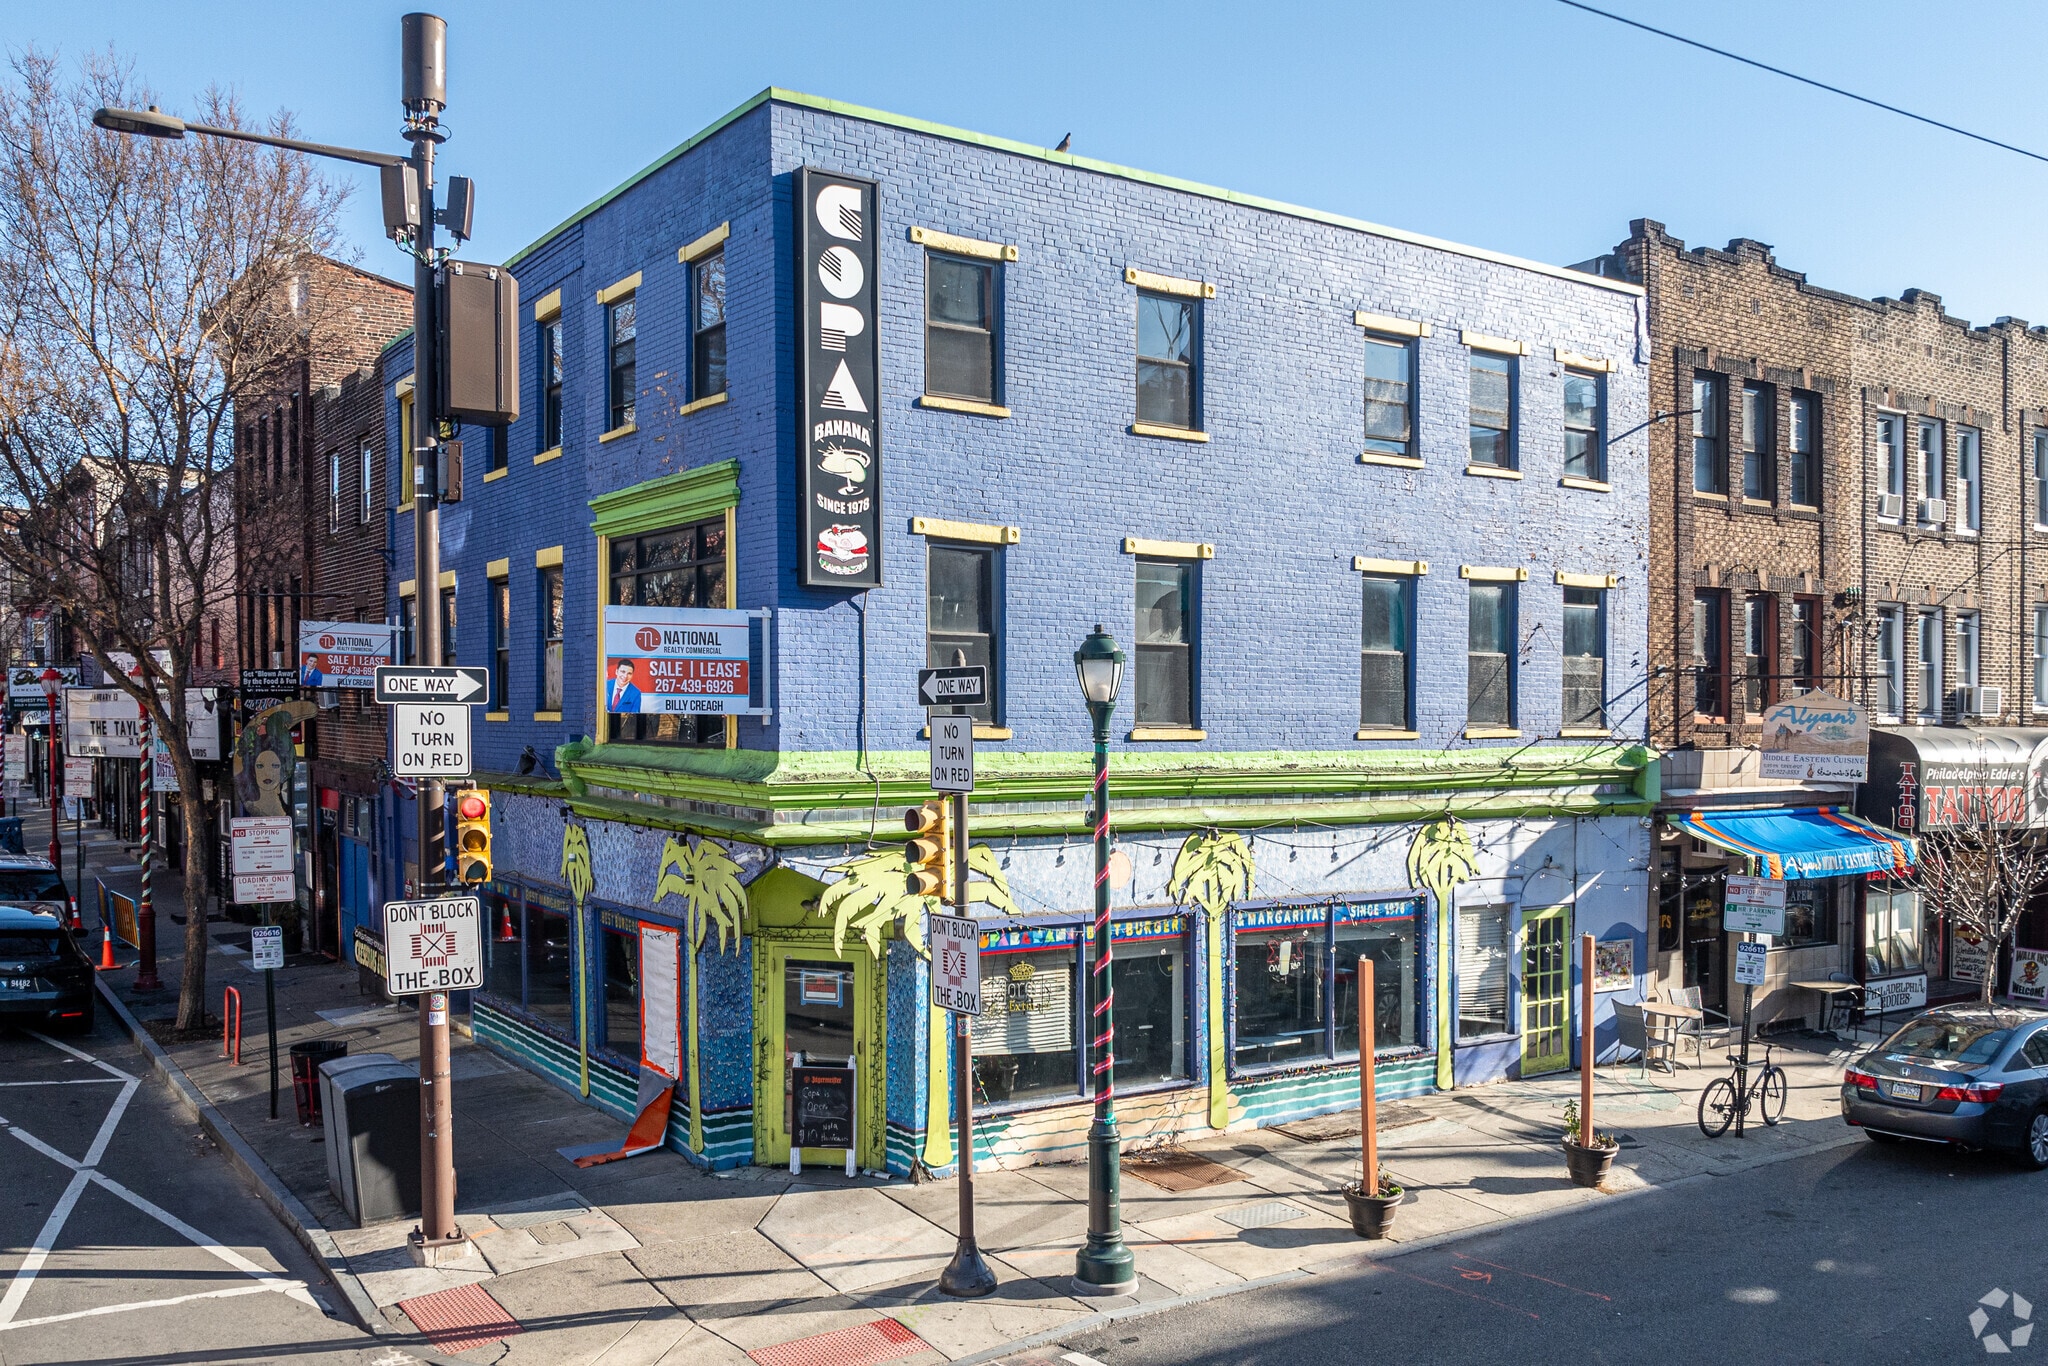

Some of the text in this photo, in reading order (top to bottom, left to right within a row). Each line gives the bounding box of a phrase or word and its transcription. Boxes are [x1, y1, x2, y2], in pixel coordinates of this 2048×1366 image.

[815, 184, 868, 414] COPA
[814, 419, 871, 447] BANANA
[816, 492, 870, 515] SINCE 1978
[337, 637, 373, 647] NATIONAL
[664, 631, 722, 646] NATIONAL
[685, 647, 722, 655] COMMERCIAL
[328, 655, 386, 666] SALE LEASE
[243, 670, 254, 678] Get
[331, 665, 375, 675] 267-439-692
[650, 660, 741, 678] SALE LEASE
[263, 677, 279, 685] Food
[353, 678, 374, 686] CREAGH
[389, 678, 454, 692] ONE WAY
[655, 678, 734, 694] 267-439-6926
[937, 678, 978, 694] ONE WAY
[665, 699, 723, 712] BILLY CREAGH
[420, 712, 445, 725] NO
[1769, 704, 1857, 732] Alyan's
[90, 720, 152, 735] THE TAYLR
[944, 724, 959, 739] NO
[411, 732, 454, 746] TURN
[402, 753, 463, 766] ON RED
[939, 746, 964, 760] TURN
[1762, 753, 1865, 765] MIDDLE EASTERN CUISINE
[935, 766, 970, 783] ON RED
[1926, 768, 2025, 782] Philadelphia Eddie's
[1897, 762, 1919, 829] TATTOO
[1923, 786, 2026, 825] TATTOO
[1741, 888, 1772, 896] STOPPING
[390, 902, 474, 923] DON'T BLOCK
[1248, 908, 1327, 926] MARGARITAS
[1350, 902, 1406, 918] SINCE 1978
[1749, 907, 1776, 915] PARKING
[254, 929, 280, 937] 926616
[932, 917, 976, 940] DON'T BLOCK
[1126, 918, 1187, 937] BURGERS
[1740, 945, 1764, 953] 926613
[2016, 951, 2036, 962] WALK
[395, 967, 475, 990] THE BOX
[1866, 978, 1926, 1002] PHILADELPHIA
[2012, 984, 2046, 998] WELCOME
[935, 985, 952, 1006] THE
[957, 990, 977, 1012] BOX
